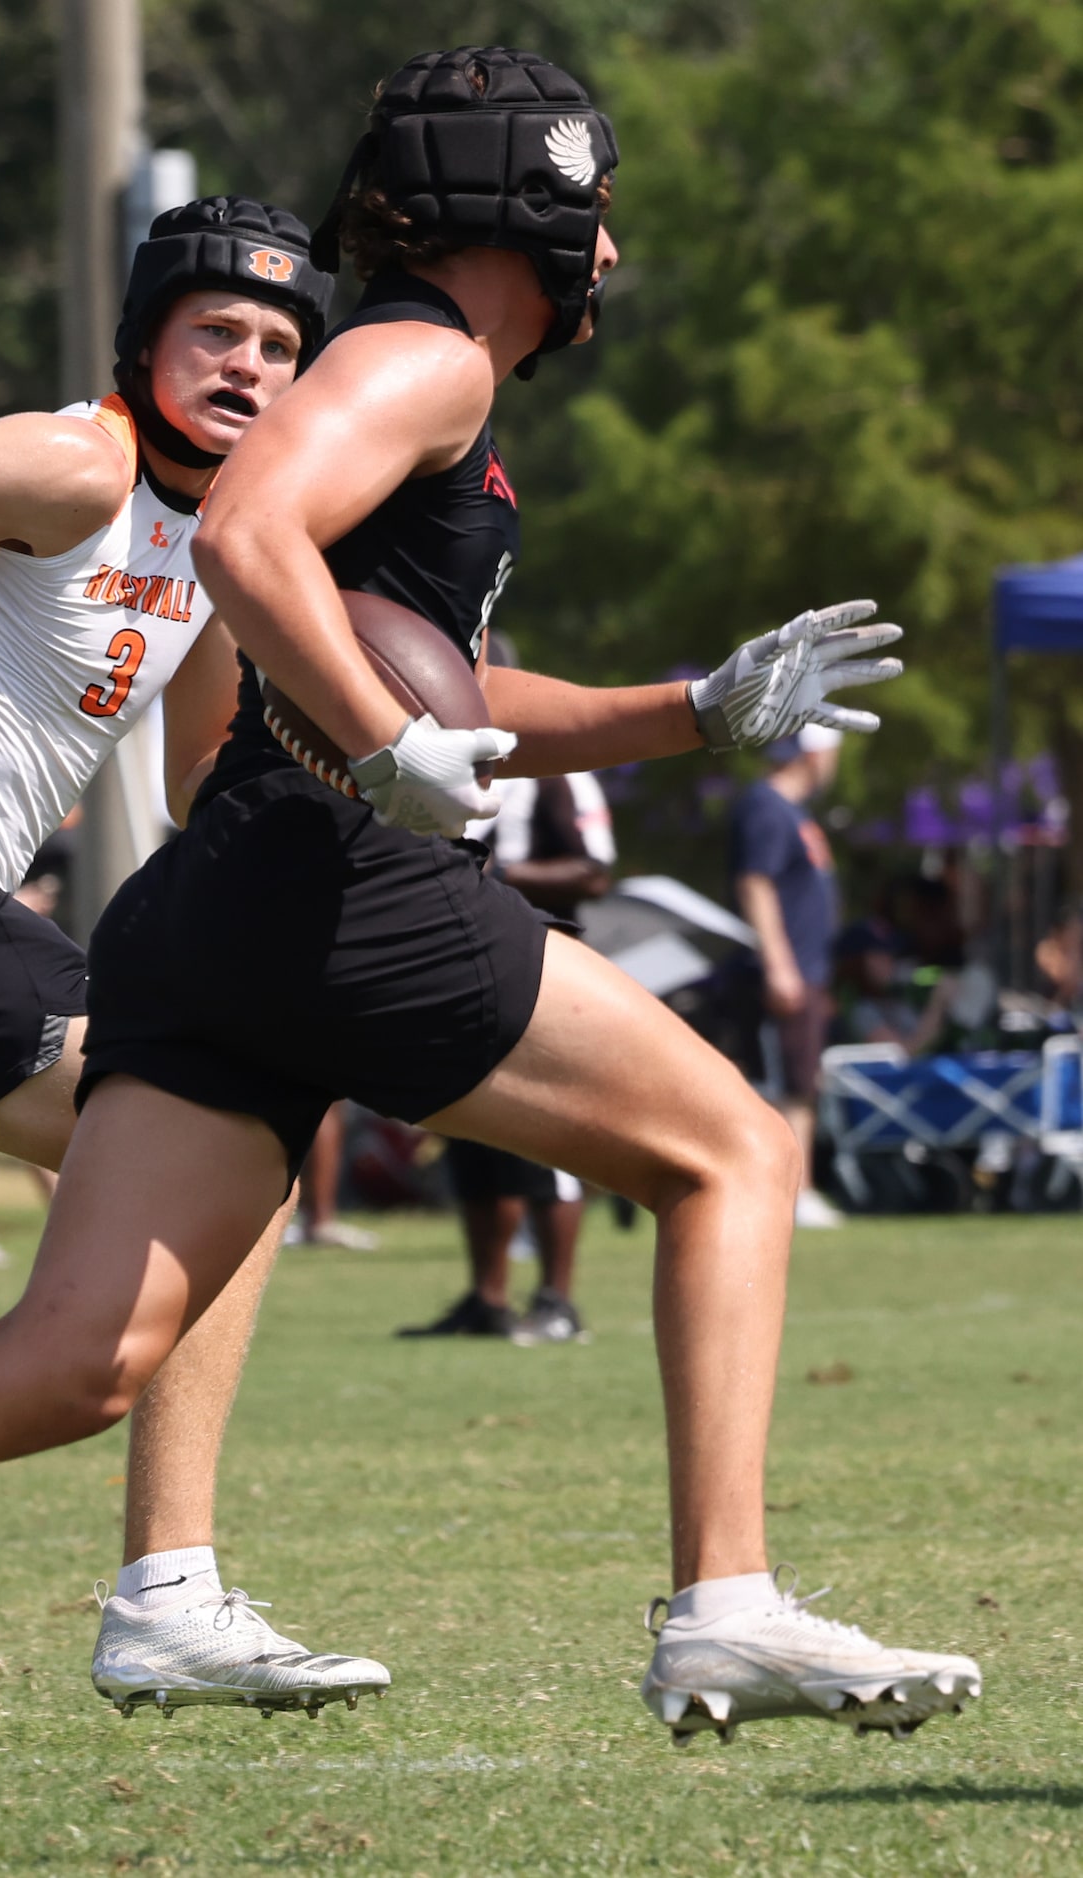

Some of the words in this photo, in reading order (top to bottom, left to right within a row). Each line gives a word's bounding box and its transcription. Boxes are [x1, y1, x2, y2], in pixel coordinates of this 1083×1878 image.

[248, 249, 293, 282] R
[83, 564, 196, 622] ROCKWALL
[79, 628, 146, 717] 3
